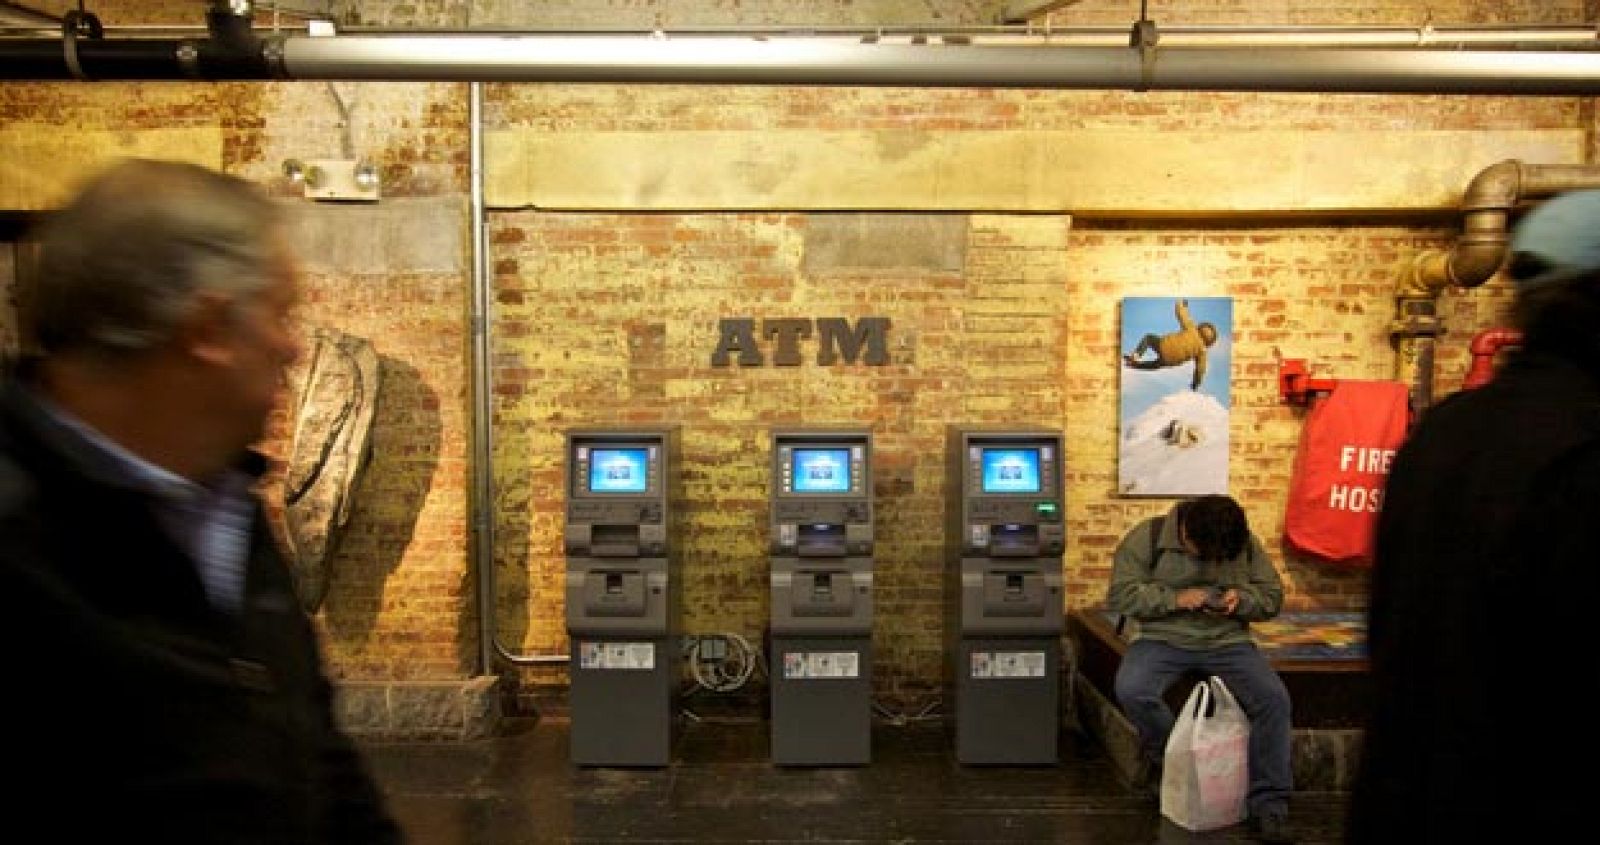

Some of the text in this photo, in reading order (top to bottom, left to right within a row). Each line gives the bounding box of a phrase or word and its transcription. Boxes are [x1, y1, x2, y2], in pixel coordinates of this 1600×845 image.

[711, 317, 891, 367] ATM
[1340, 445, 1396, 474] FIRE
[1328, 484, 1385, 513] HOS
